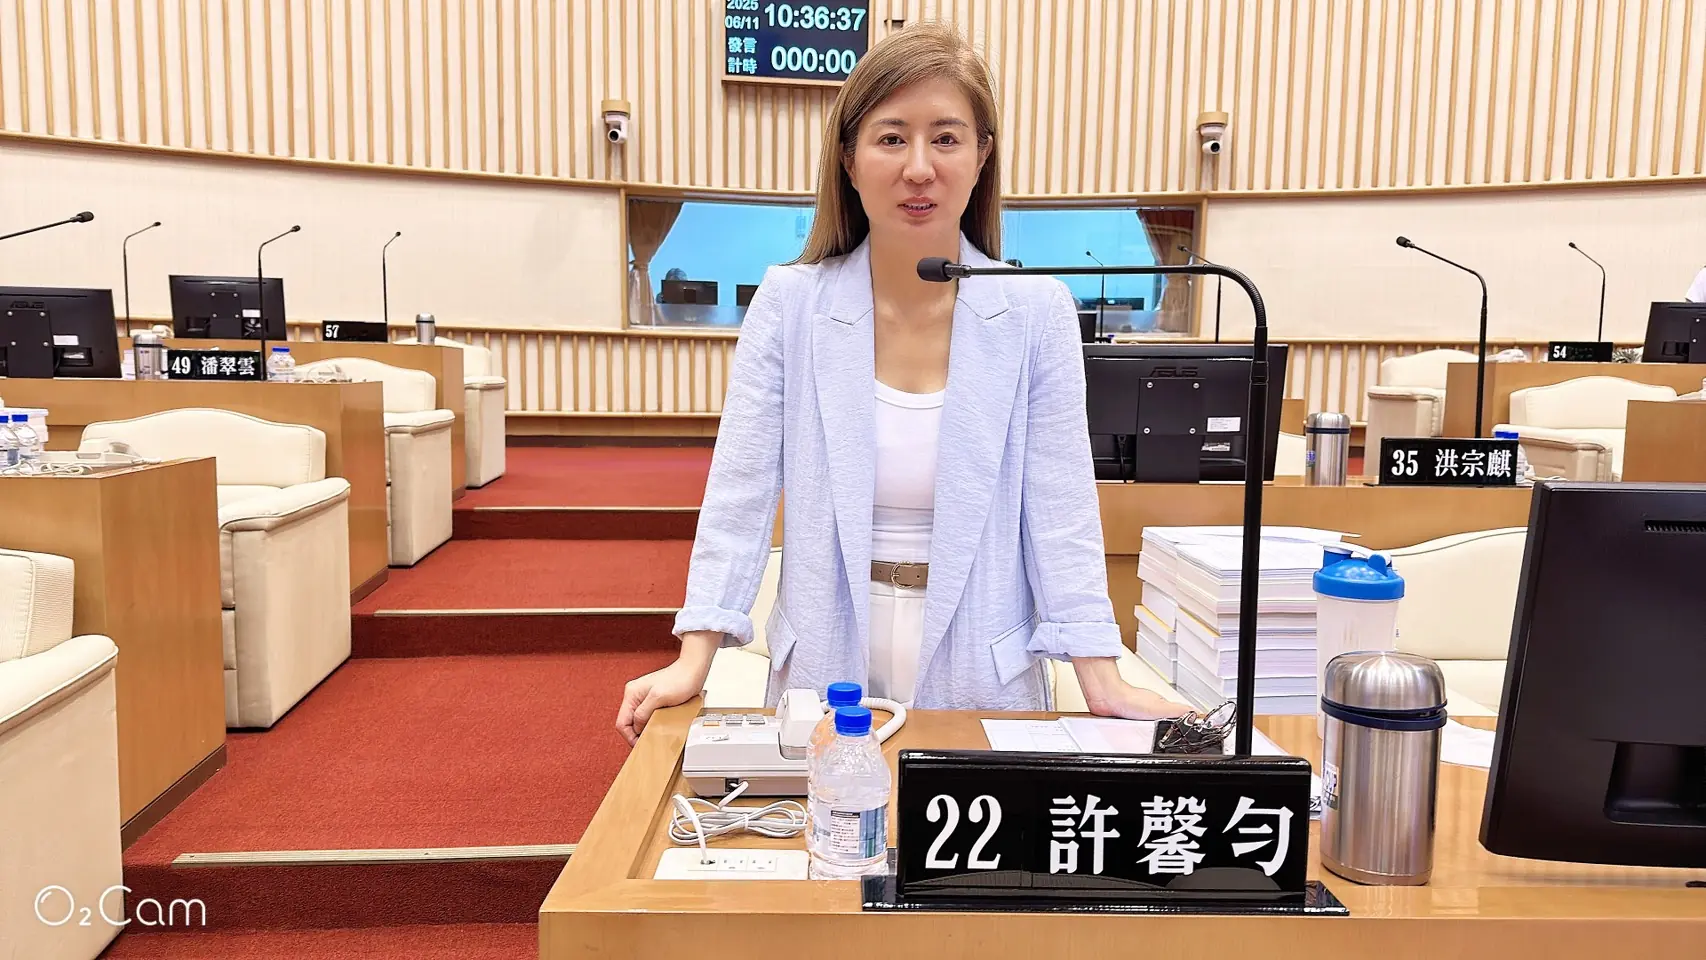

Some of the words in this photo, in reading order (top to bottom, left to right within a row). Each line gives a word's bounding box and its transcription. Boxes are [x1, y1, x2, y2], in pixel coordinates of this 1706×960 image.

[725, 15, 759, 30] 06/11
[765, 3, 866, 31] 10:36:37
[728, 37, 757, 53] 發言
[728, 57, 757, 74] 計時
[771, 46, 857, 74] 000:00
[325, 324, 340, 338] 57
[1553, 345, 1567, 358] 54
[171, 356, 191, 374] 49
[1391, 449, 1419, 476] 35
[925, 794, 1002, 869] 22
[1049, 794, 1294, 876] 許馨勻
